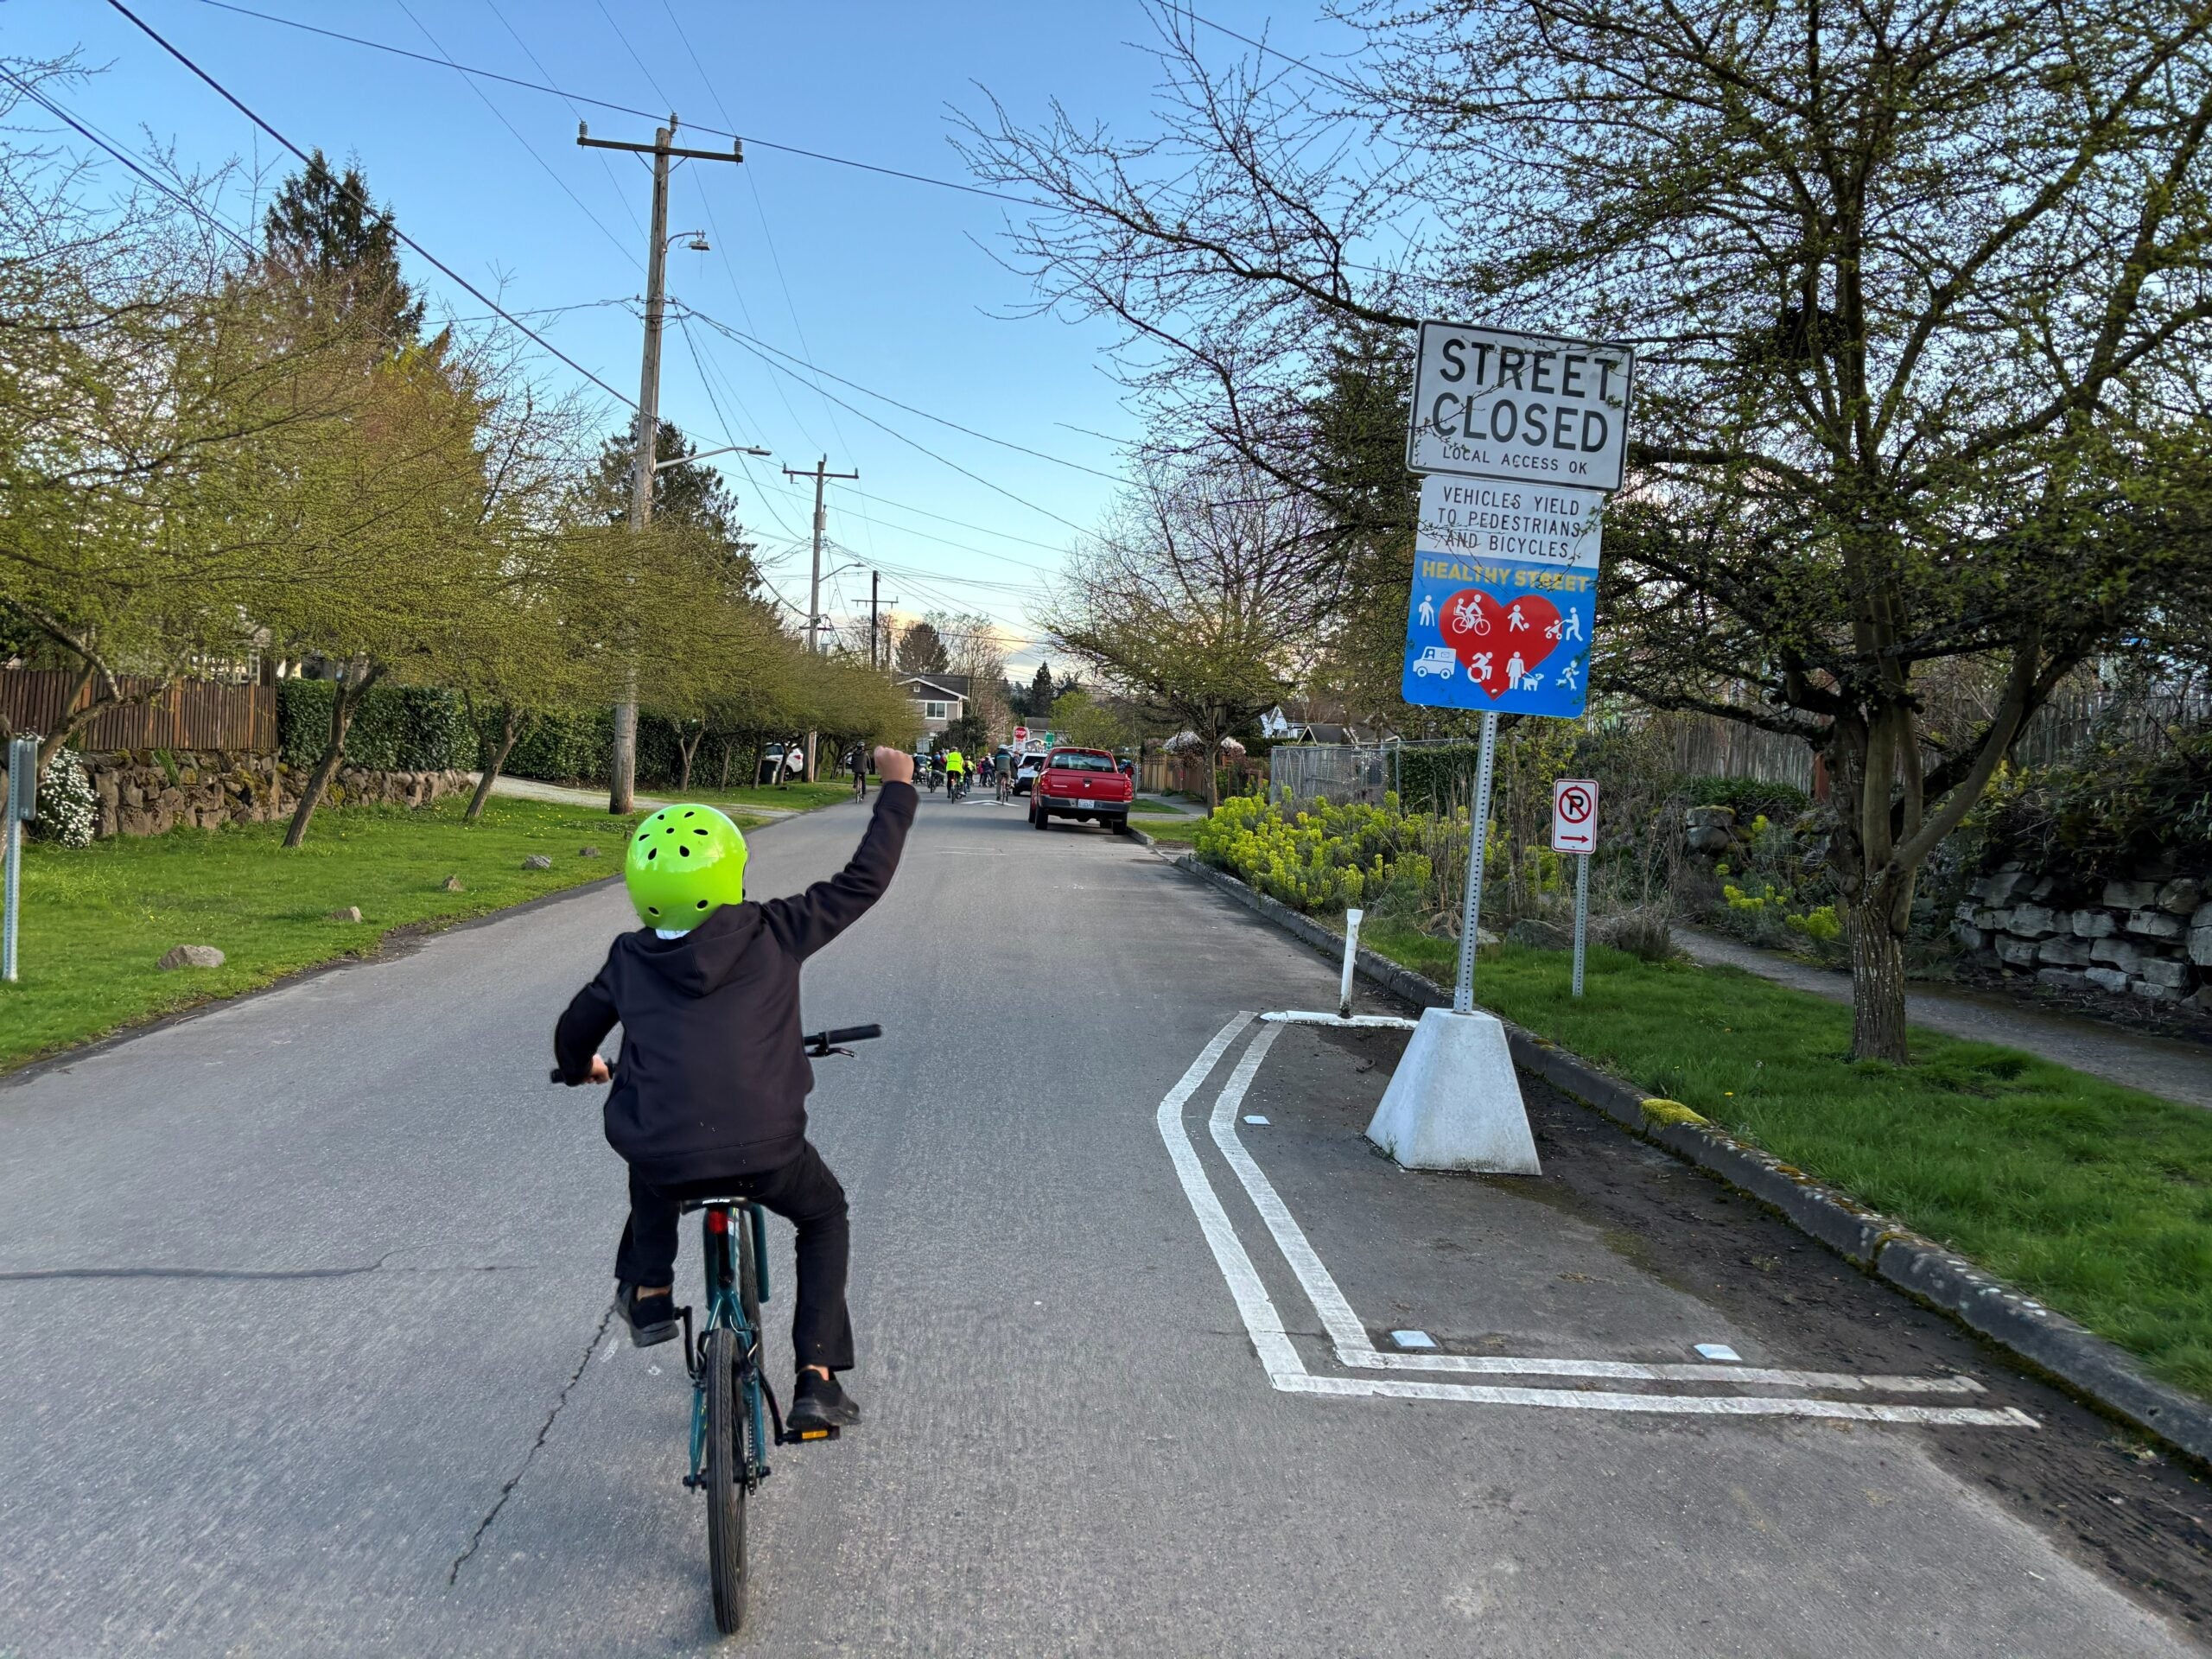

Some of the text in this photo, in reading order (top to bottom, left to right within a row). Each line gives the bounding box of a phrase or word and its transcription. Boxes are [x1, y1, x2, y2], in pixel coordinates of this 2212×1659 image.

[1440, 338, 1617, 401] STREET
[1433, 392, 1608, 453] CLOSED
[1443, 448, 1587, 474] LOCAL ACCESS OK
[1443, 486, 1580, 515] VEHICLES YIELD
[1438, 508, 1580, 537] TO PEDESTRIANS
[1446, 531, 1568, 558] AND BICYCLES
[1422, 561, 1590, 593] HEALTHY STREET
